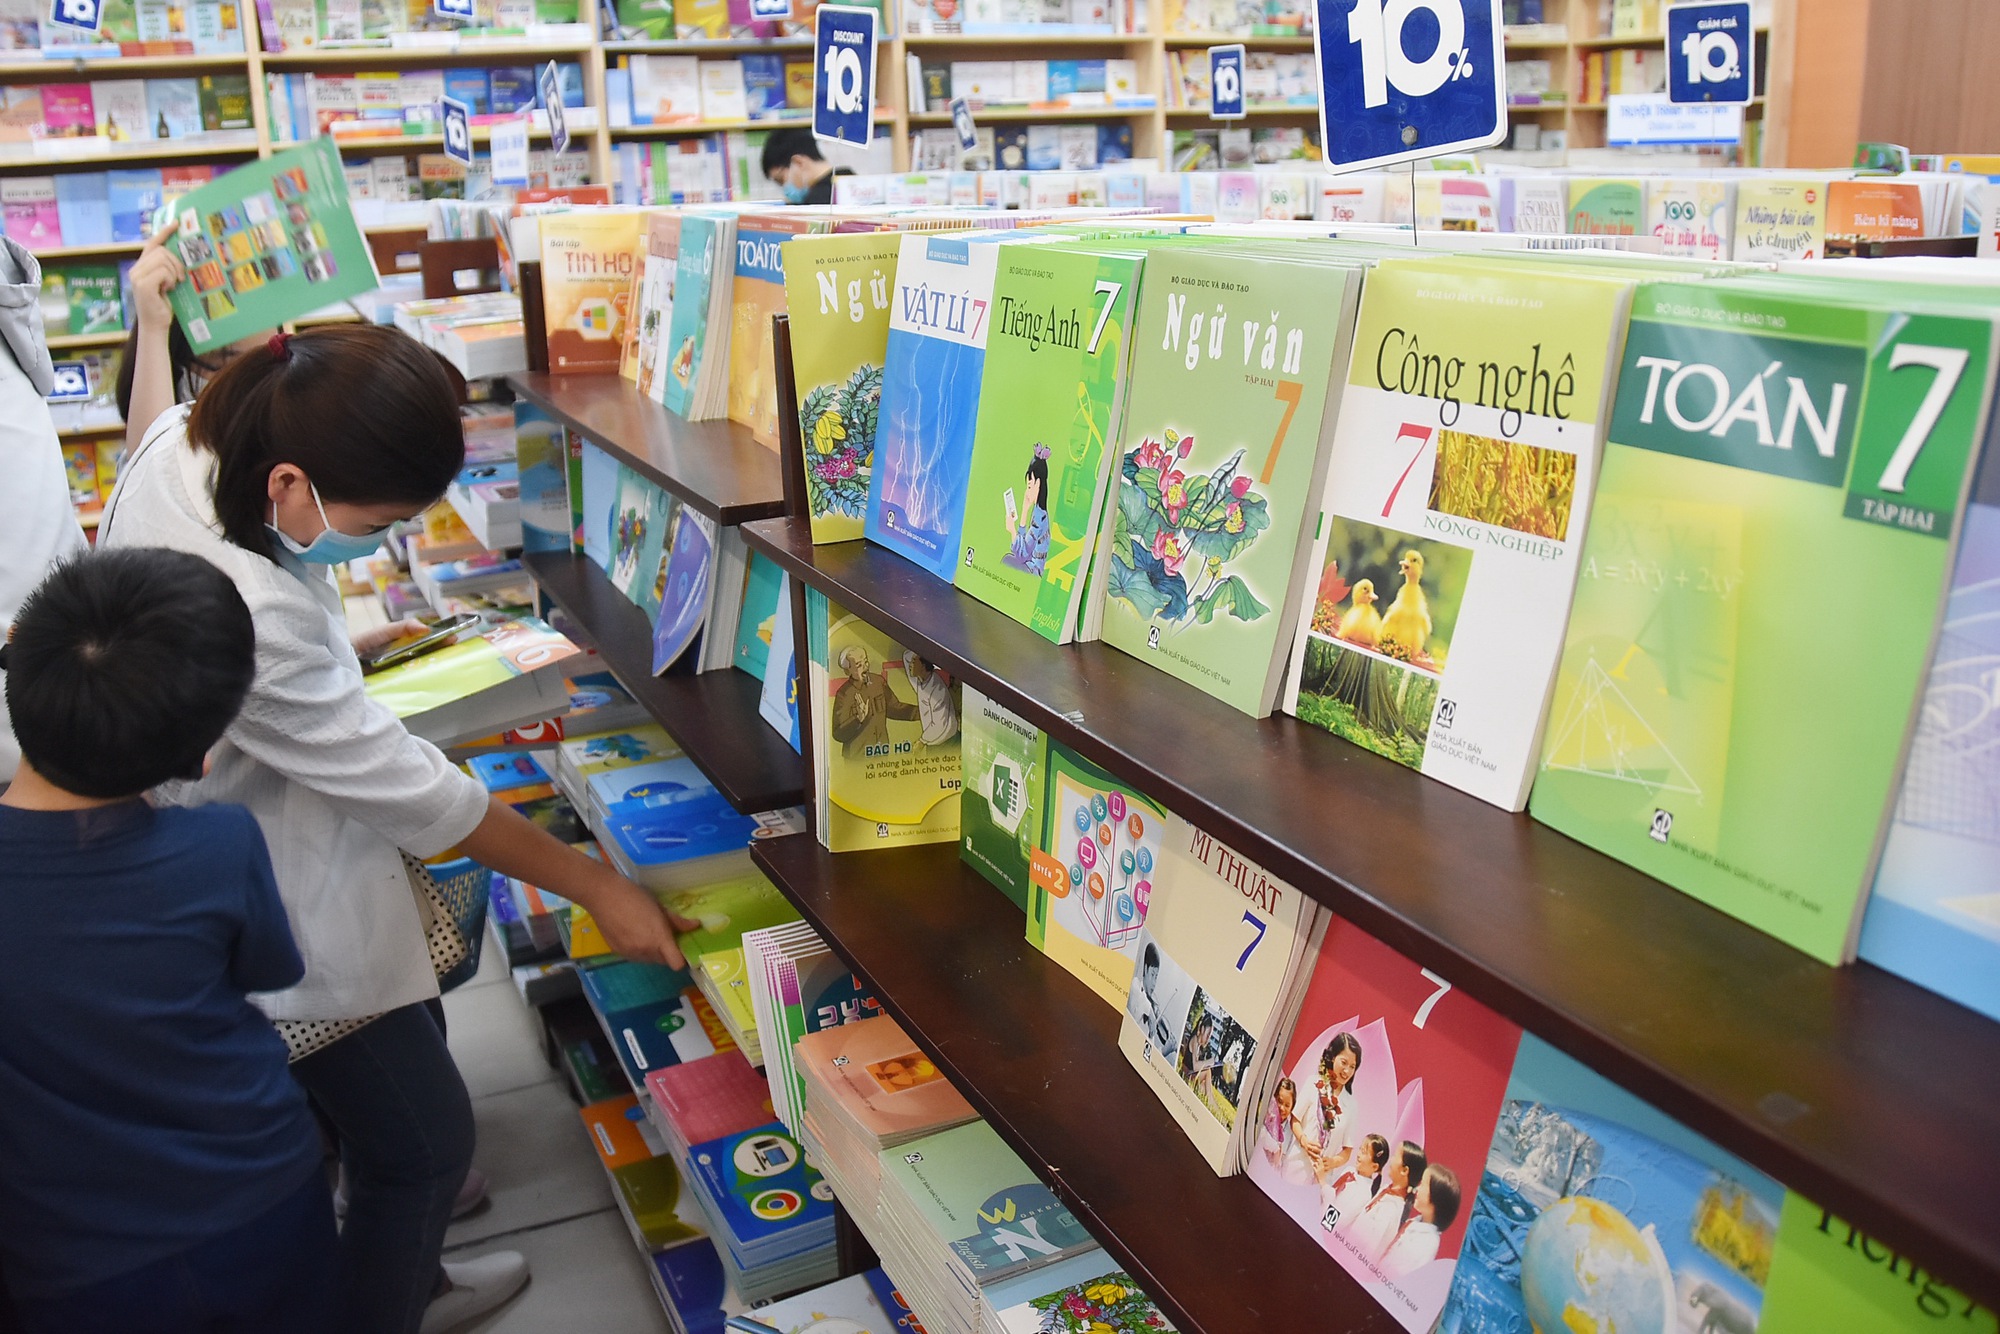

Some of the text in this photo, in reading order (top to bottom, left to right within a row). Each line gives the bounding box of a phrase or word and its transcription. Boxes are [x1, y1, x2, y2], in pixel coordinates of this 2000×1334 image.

[833, 30, 864, 44] DISCOUNT
[1697, 15, 1738, 30] GIẢM GIÁ
[1347, 0, 1473, 109] 10%
[1682, 31, 1741, 84] 10%
[825, 45, 863, 114] 10%
[1664, 200, 1696, 220] 100
[565, 252, 632, 277] TIN HỌ
[703, 234, 712, 275] 6
[815, 269, 889, 322] Ngữ
[1171, 275, 1250, 293] BỘ GIÁO DỤC VÀ ĐÀO TẠO
[901, 281, 988, 340] VẬT LÍ 7
[999, 280, 1122, 355] Tiếng Anh 7
[1162, 293, 1303, 375] Ngữ văn
[1244, 374, 1274, 388] TẬP HAI
[1376, 327, 1575, 438] Công nghệ
[1635, 355, 1848, 458] TOÁN
[1876, 342, 1970, 493] 7
[1258, 379, 1304, 485] 7
[1380, 422, 1433, 519] 7
[1862, 498, 1934, 532] TẬP HAI
[1423, 514, 1563, 563] NÔNG NGHIỆP
[1583, 556, 1599, 579] A
[1032, 607, 1060, 632] English
[983, 707, 1000, 723] DÀNH
[1000, 716, 1014, 729] CHO
[1013, 722, 1032, 741] TRUNG
[865, 738, 911, 756] BÁC HỒ
[914, 756, 928, 765] học
[942, 754, 956, 763] đạo
[1431, 740, 1497, 772] GIÁO DỤC VIỆT NAM
[922, 765, 937, 773] cho
[940, 764, 955, 772] học
[940, 777, 962, 790] Lớp
[1053, 868, 1065, 892] 2
[1216, 845, 1282, 917] THUẬT
[1235, 908, 1267, 974] 7
[1412, 967, 1452, 1030] 7
[954, 1239, 989, 1271] English
[1333, 1230, 1419, 1312] NHÀ XUẤT BẢN GIÁO DỤC VIỆT NAM
